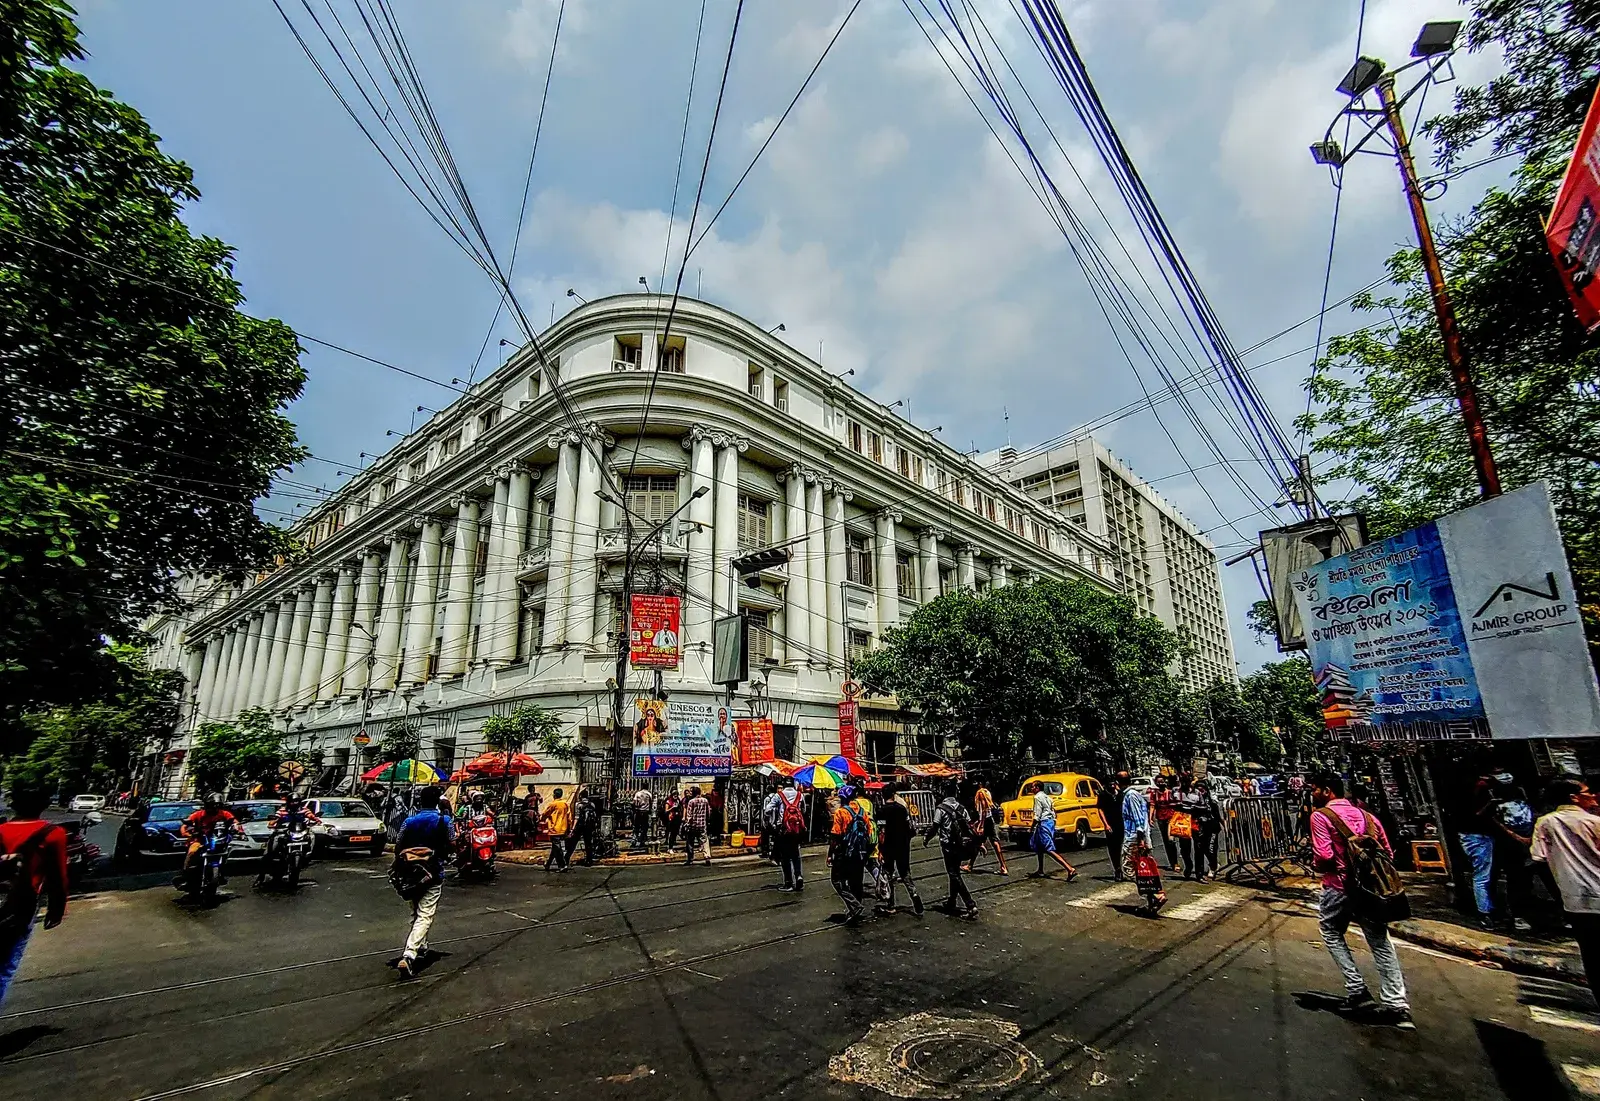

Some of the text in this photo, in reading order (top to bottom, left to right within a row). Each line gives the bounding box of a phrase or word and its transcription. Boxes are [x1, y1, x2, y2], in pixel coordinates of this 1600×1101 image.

[1310, 578, 1413, 621] বইমেলা
[1311, 601, 1439, 642] ও সাহিত্য উৎসব ২০২২
[1471, 604, 1567, 633] AJMIR GROUP
[670, 703, 705, 713] UNESCO
[840, 709, 852, 717] SALE
[654, 756, 730, 767] কলেজ স্কোয়ার
